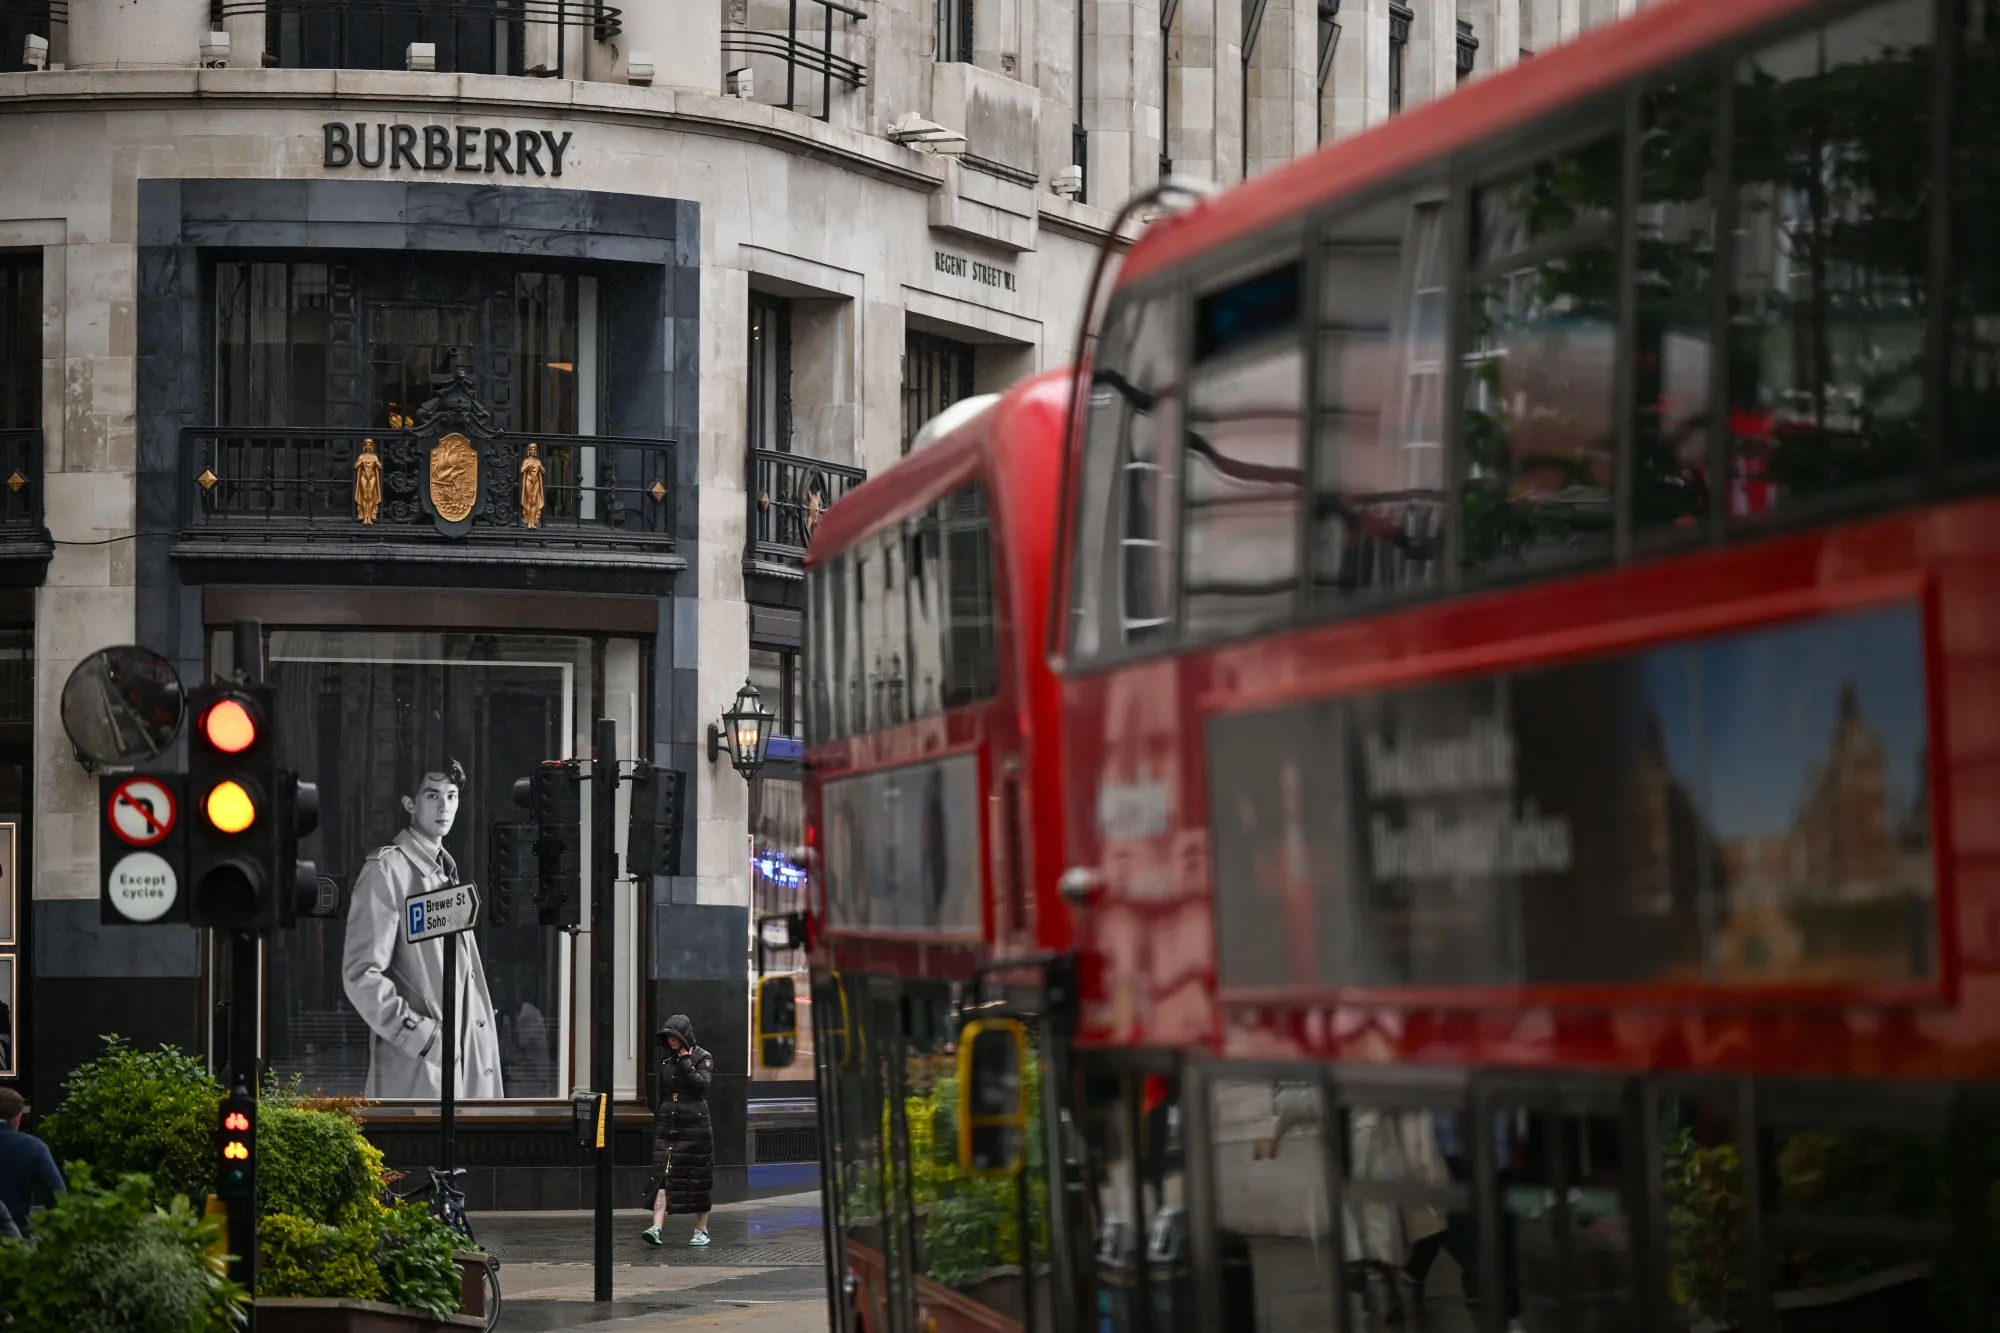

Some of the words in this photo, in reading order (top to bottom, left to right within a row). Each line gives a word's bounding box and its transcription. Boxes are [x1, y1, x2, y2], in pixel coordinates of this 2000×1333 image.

[322, 121, 573, 176] BURBERRY
[935, 251, 967, 278] REGENT
[972, 261, 1002, 288] STREET
[120, 873, 166, 887] Except
[122, 887, 164, 900] cycles
[426, 898, 453, 913] Brewer
[456, 892, 466, 906] St
[426, 915, 446, 929] Soho
